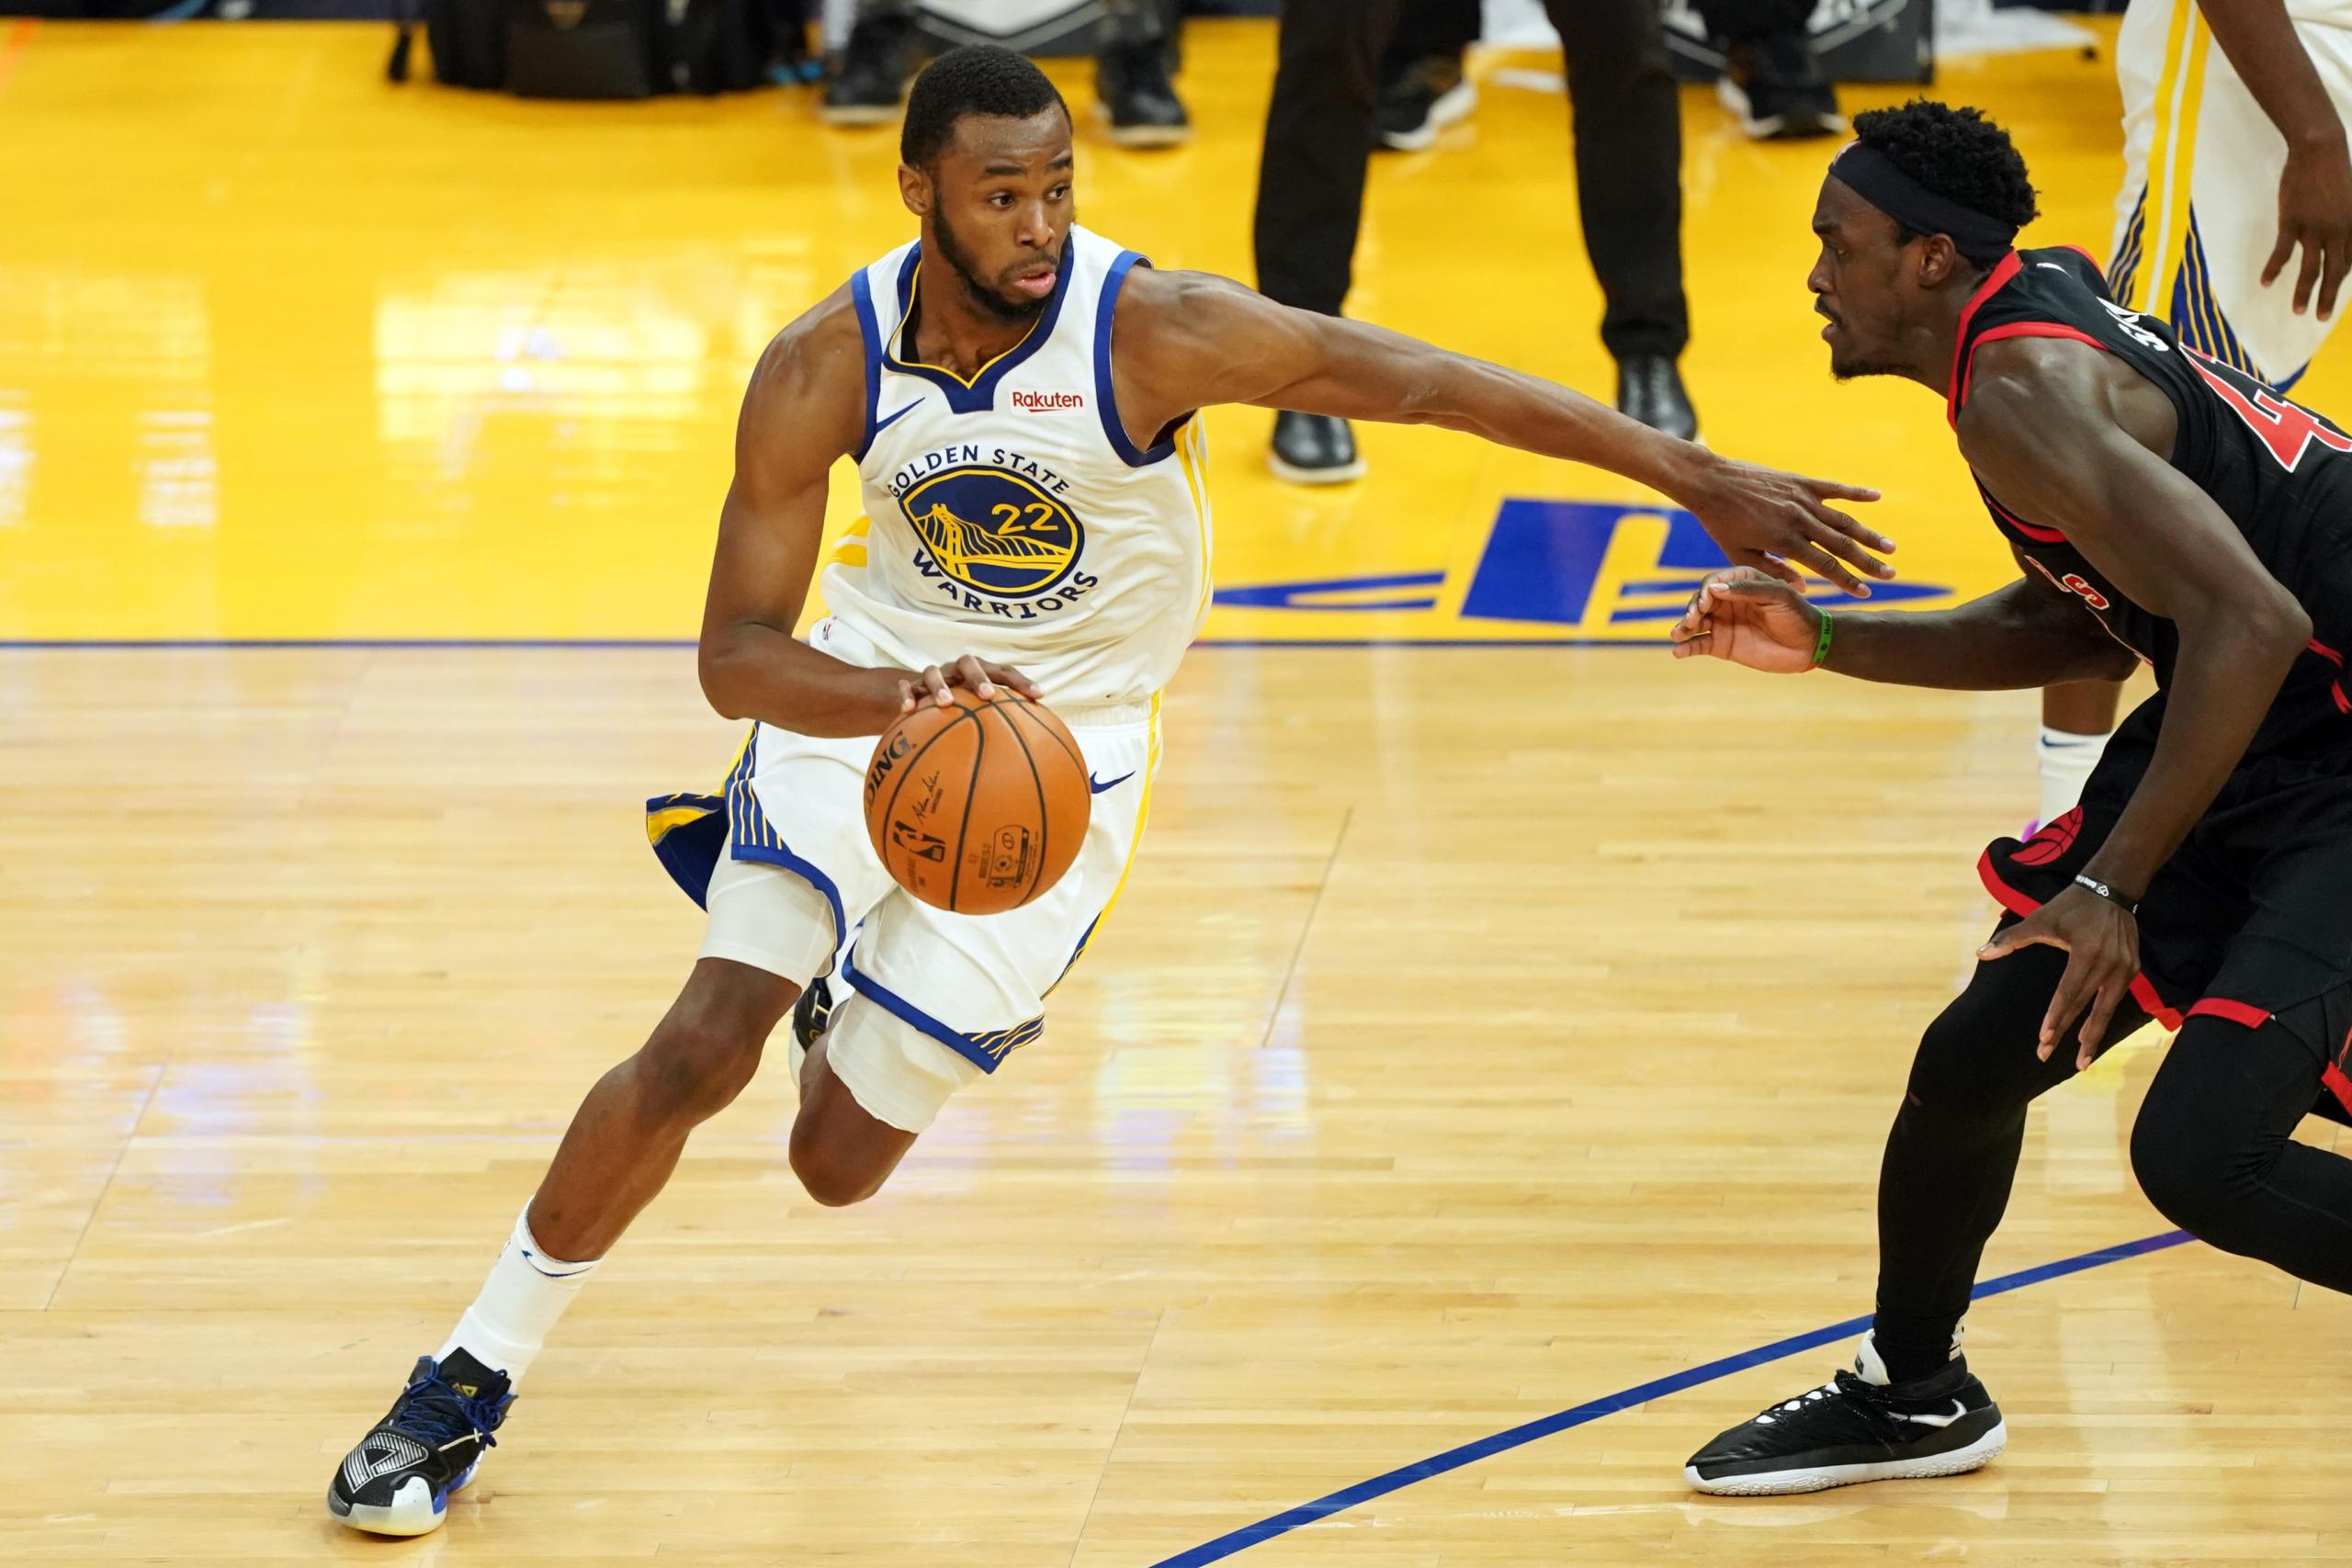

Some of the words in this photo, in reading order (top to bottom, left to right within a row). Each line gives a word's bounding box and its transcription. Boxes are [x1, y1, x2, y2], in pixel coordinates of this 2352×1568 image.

[1012, 390, 1083, 408] Rakuten
[2178, 342, 2352, 473] 4
[888, 445, 978, 499] GOLDEN
[992, 448, 1069, 494] STATE
[991, 502, 1059, 536] 22
[912, 548, 1099, 620] WARRIORS
